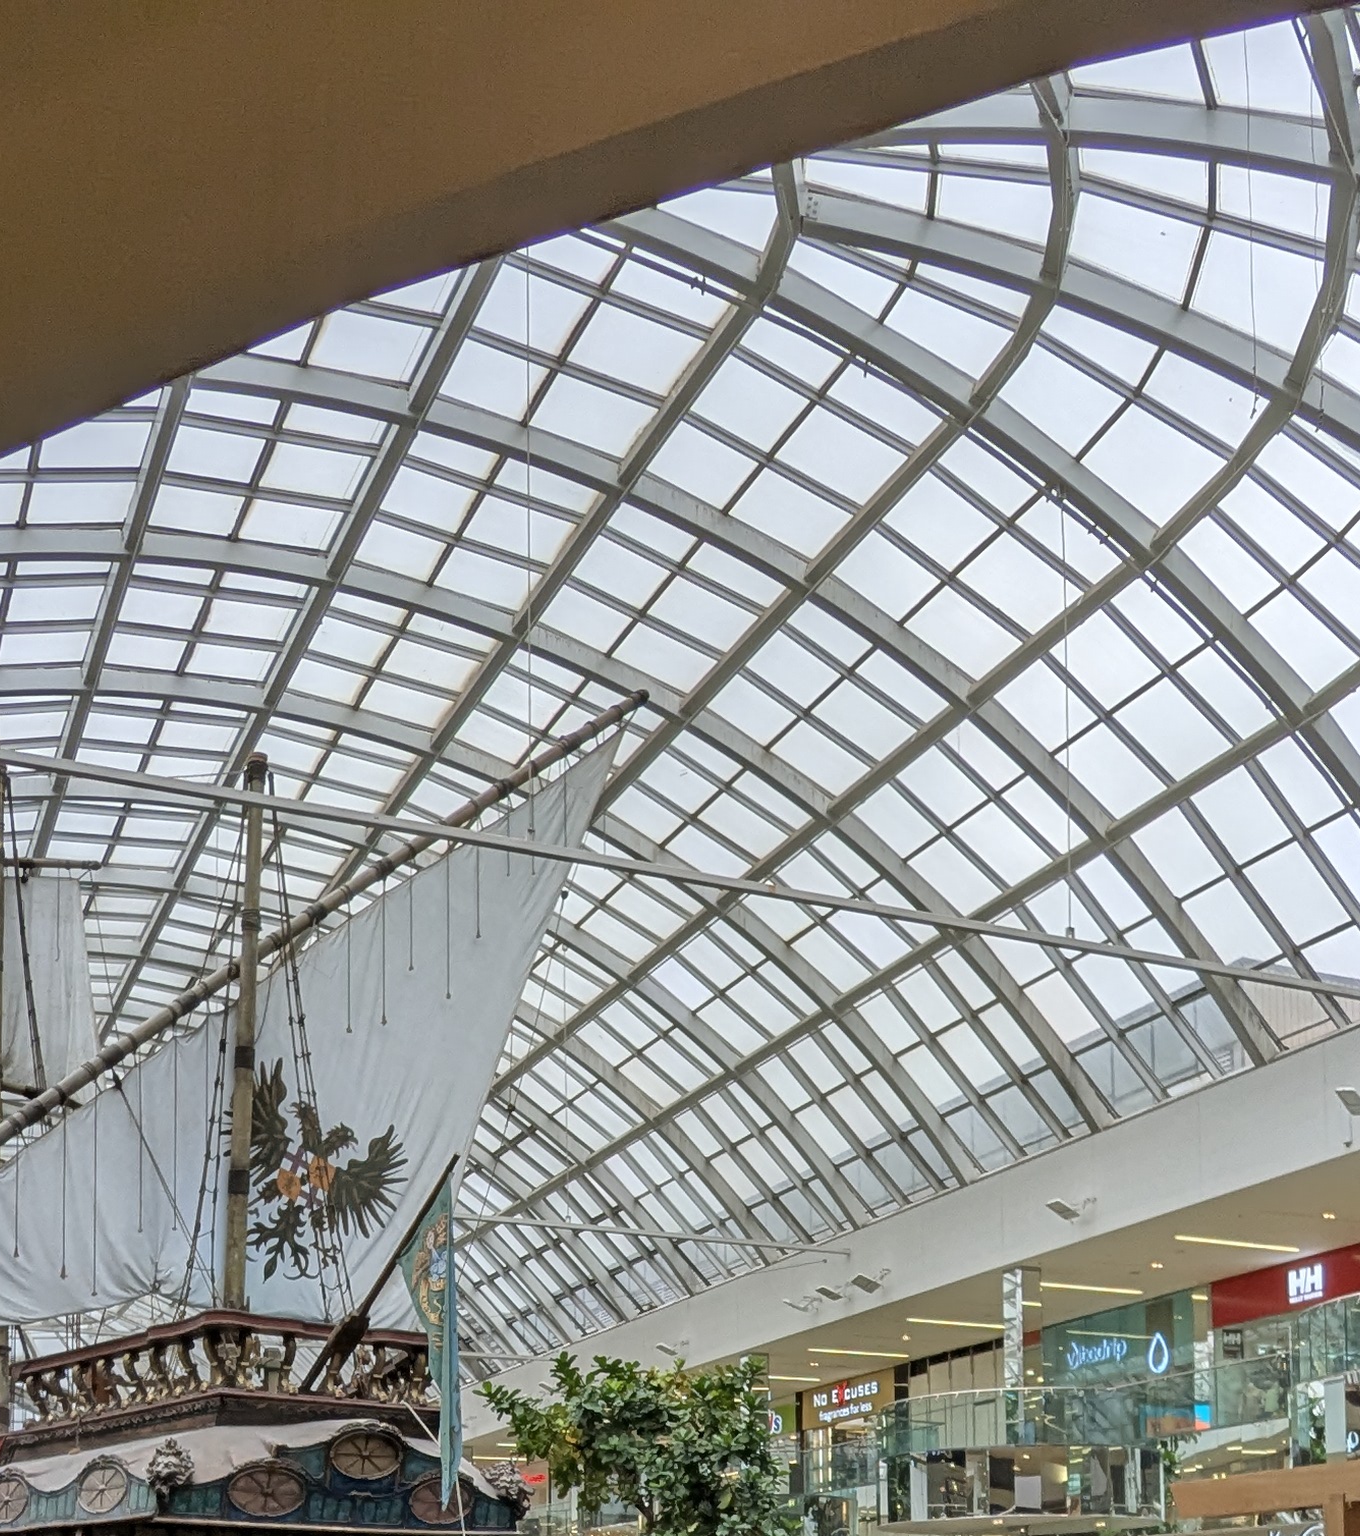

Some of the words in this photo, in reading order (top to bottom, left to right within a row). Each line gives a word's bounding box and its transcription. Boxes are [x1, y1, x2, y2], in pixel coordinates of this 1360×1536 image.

[1288, 1263, 1322, 1297] HH
[849, 1402, 860, 1416] for
[859, 1401, 873, 1413] less
